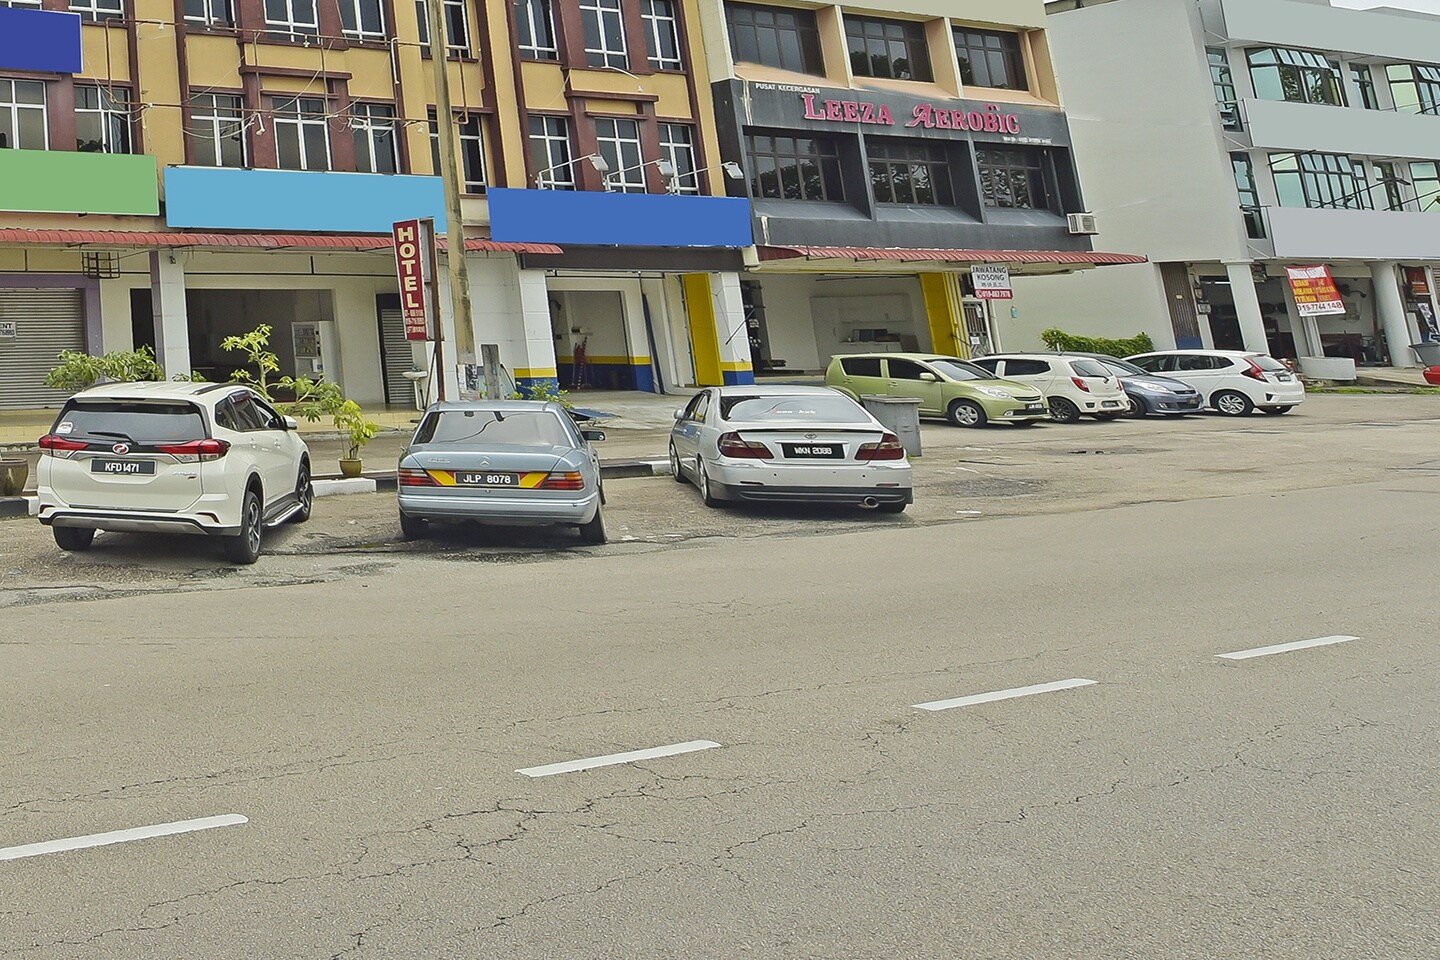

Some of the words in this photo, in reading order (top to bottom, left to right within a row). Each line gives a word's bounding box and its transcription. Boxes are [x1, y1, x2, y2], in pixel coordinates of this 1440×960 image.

[755, 83, 776, 91] PUSAT
[802, 93, 895, 126] LEEZA
[906, 104, 1020, 134] AEROBIC
[397, 226, 419, 308] HOTEL
[462, 474, 482, 484] JLP
[486, 474, 511, 484] 8078
